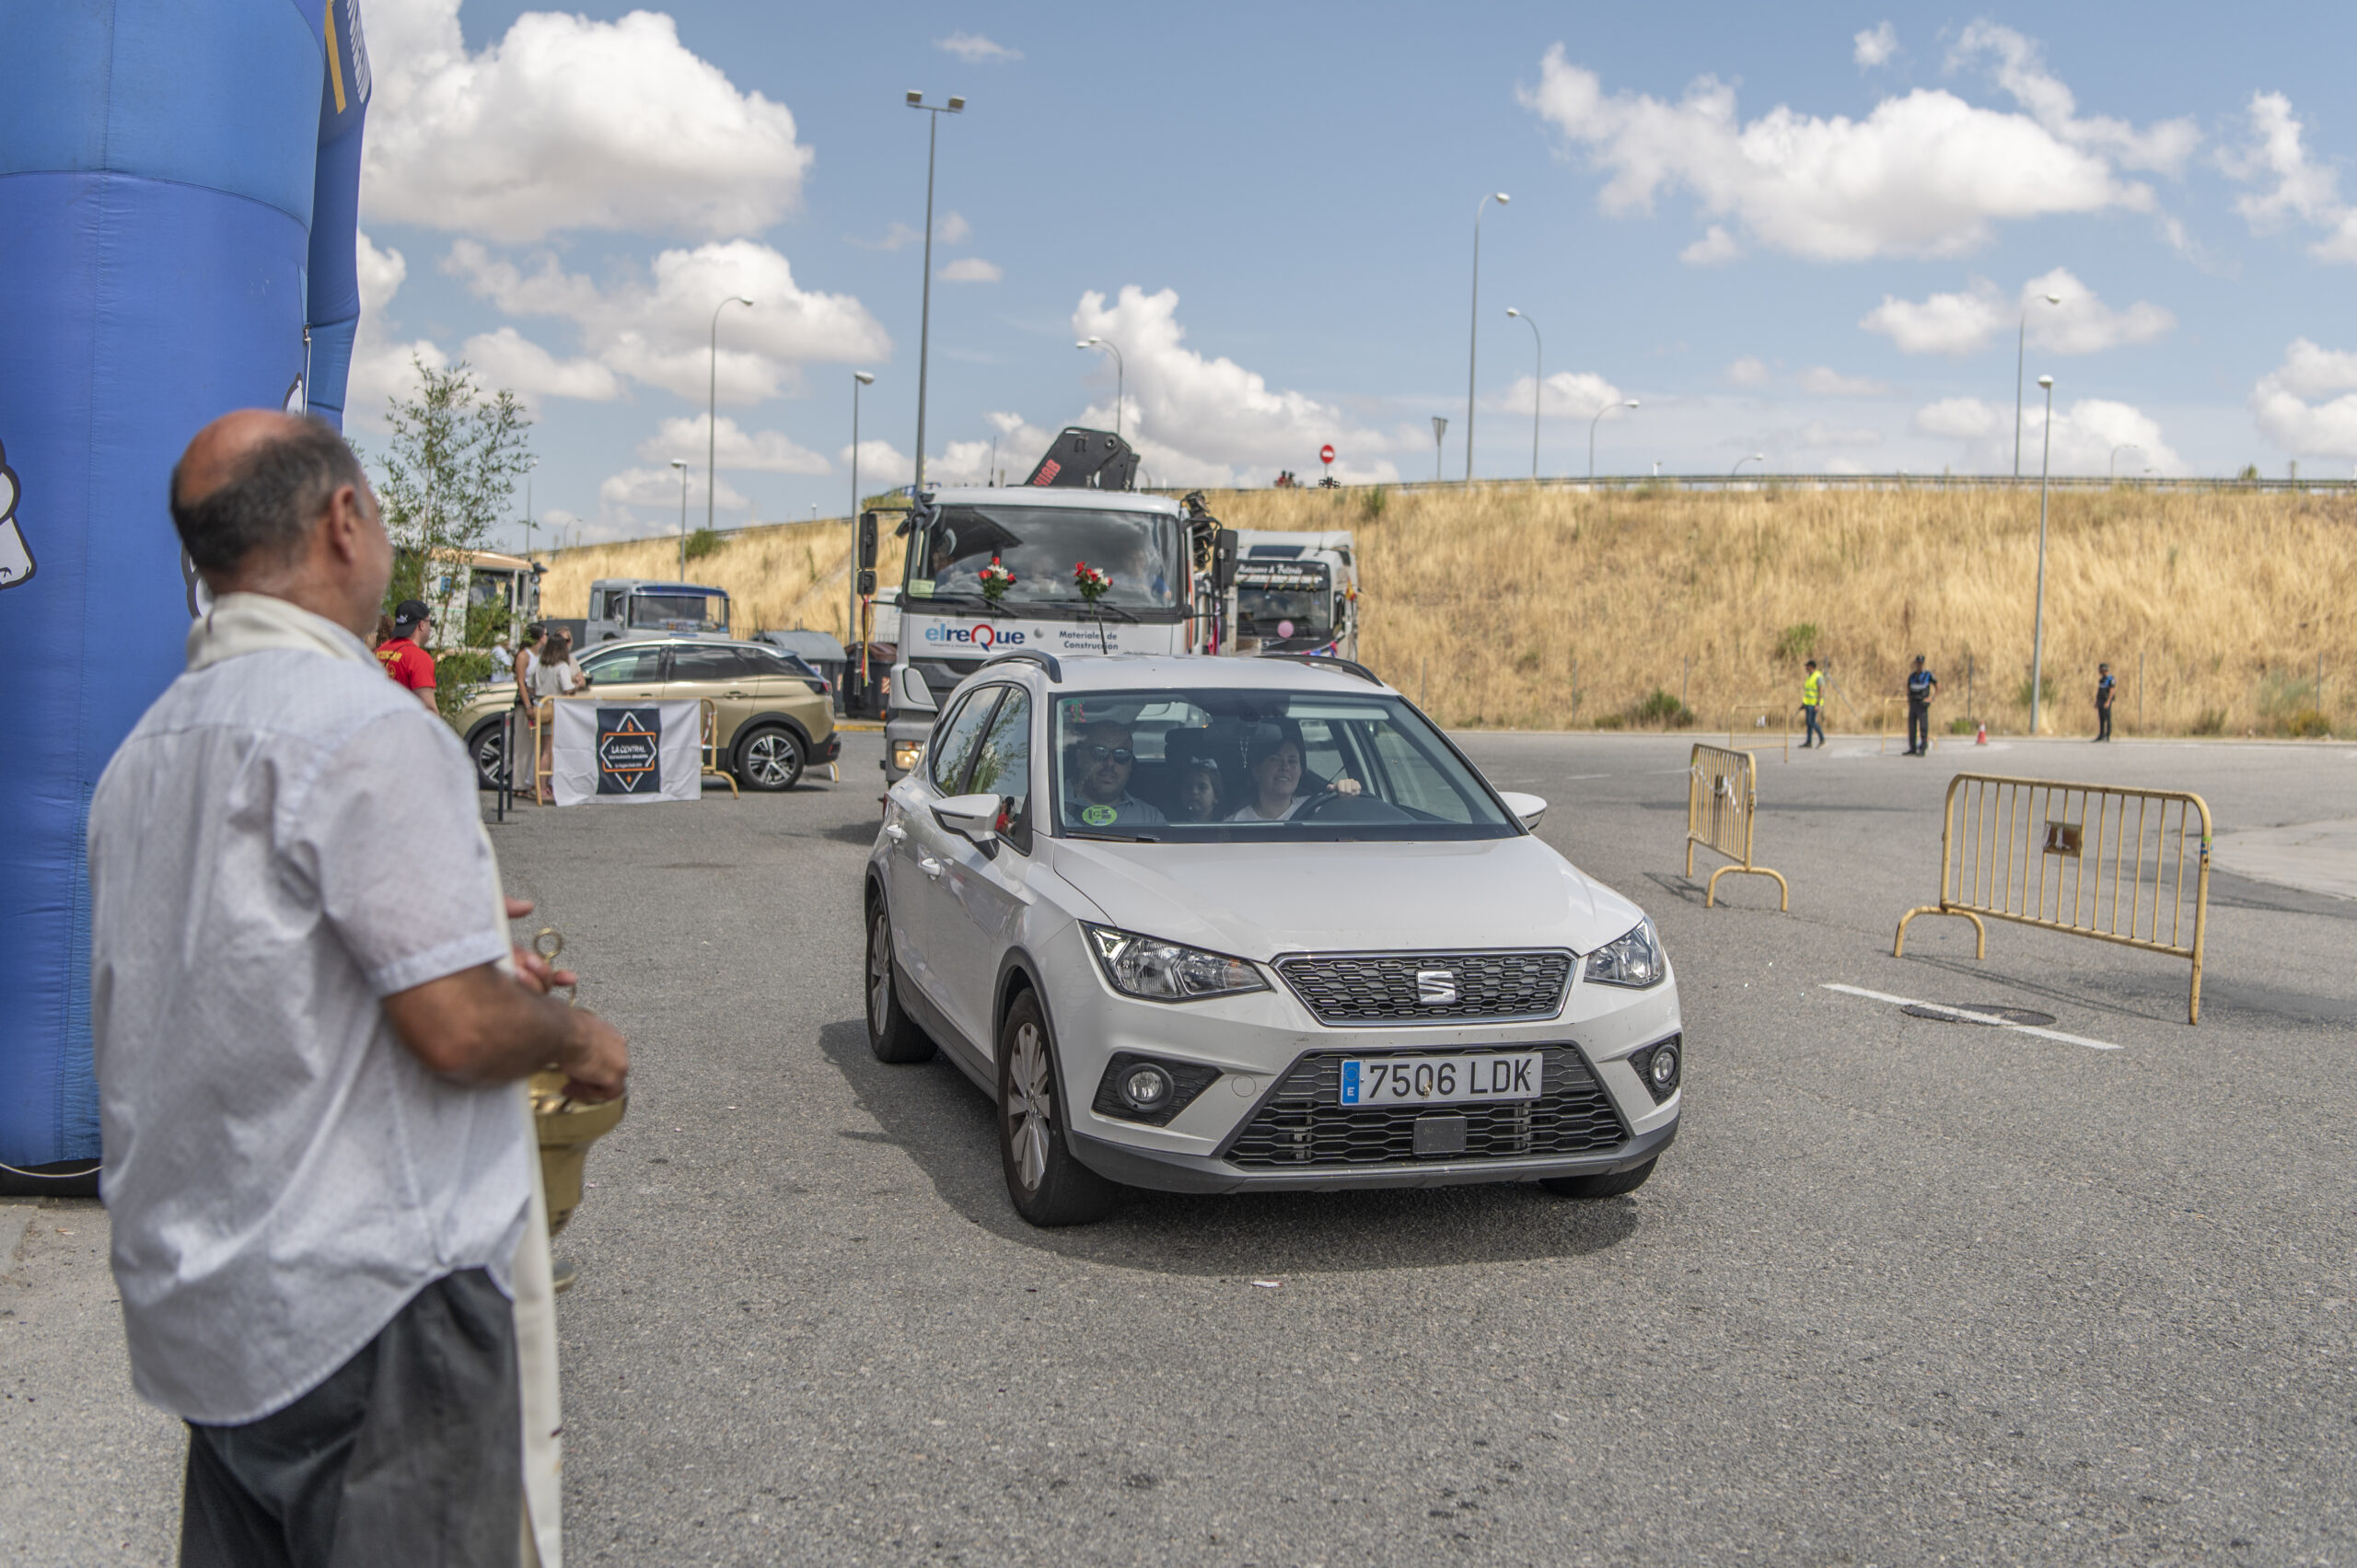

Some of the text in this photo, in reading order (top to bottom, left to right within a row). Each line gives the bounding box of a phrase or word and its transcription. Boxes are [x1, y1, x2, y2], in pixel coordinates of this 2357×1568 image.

[1107, 632, 1118, 640] de
[611, 745, 645, 754] LA CENTRAL
[1369, 1059, 1533, 1098] 7506 LDK
[1347, 1086, 1355, 1097] E
